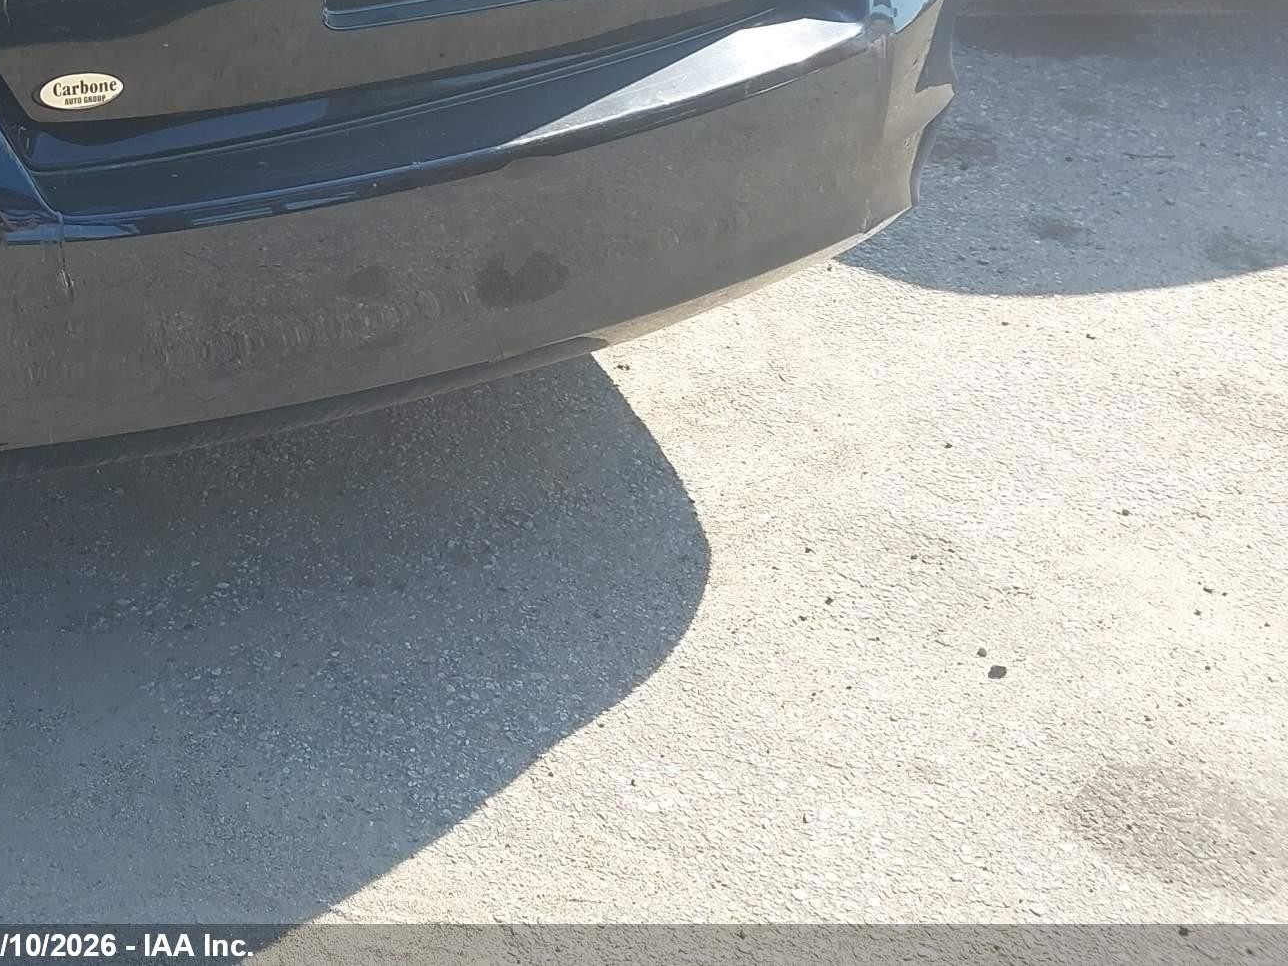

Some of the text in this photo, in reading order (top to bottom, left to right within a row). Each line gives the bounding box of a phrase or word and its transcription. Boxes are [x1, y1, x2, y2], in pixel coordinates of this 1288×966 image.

[52, 79, 117, 97] Carbone
[64, 94, 107, 106] AUTO GROUP
